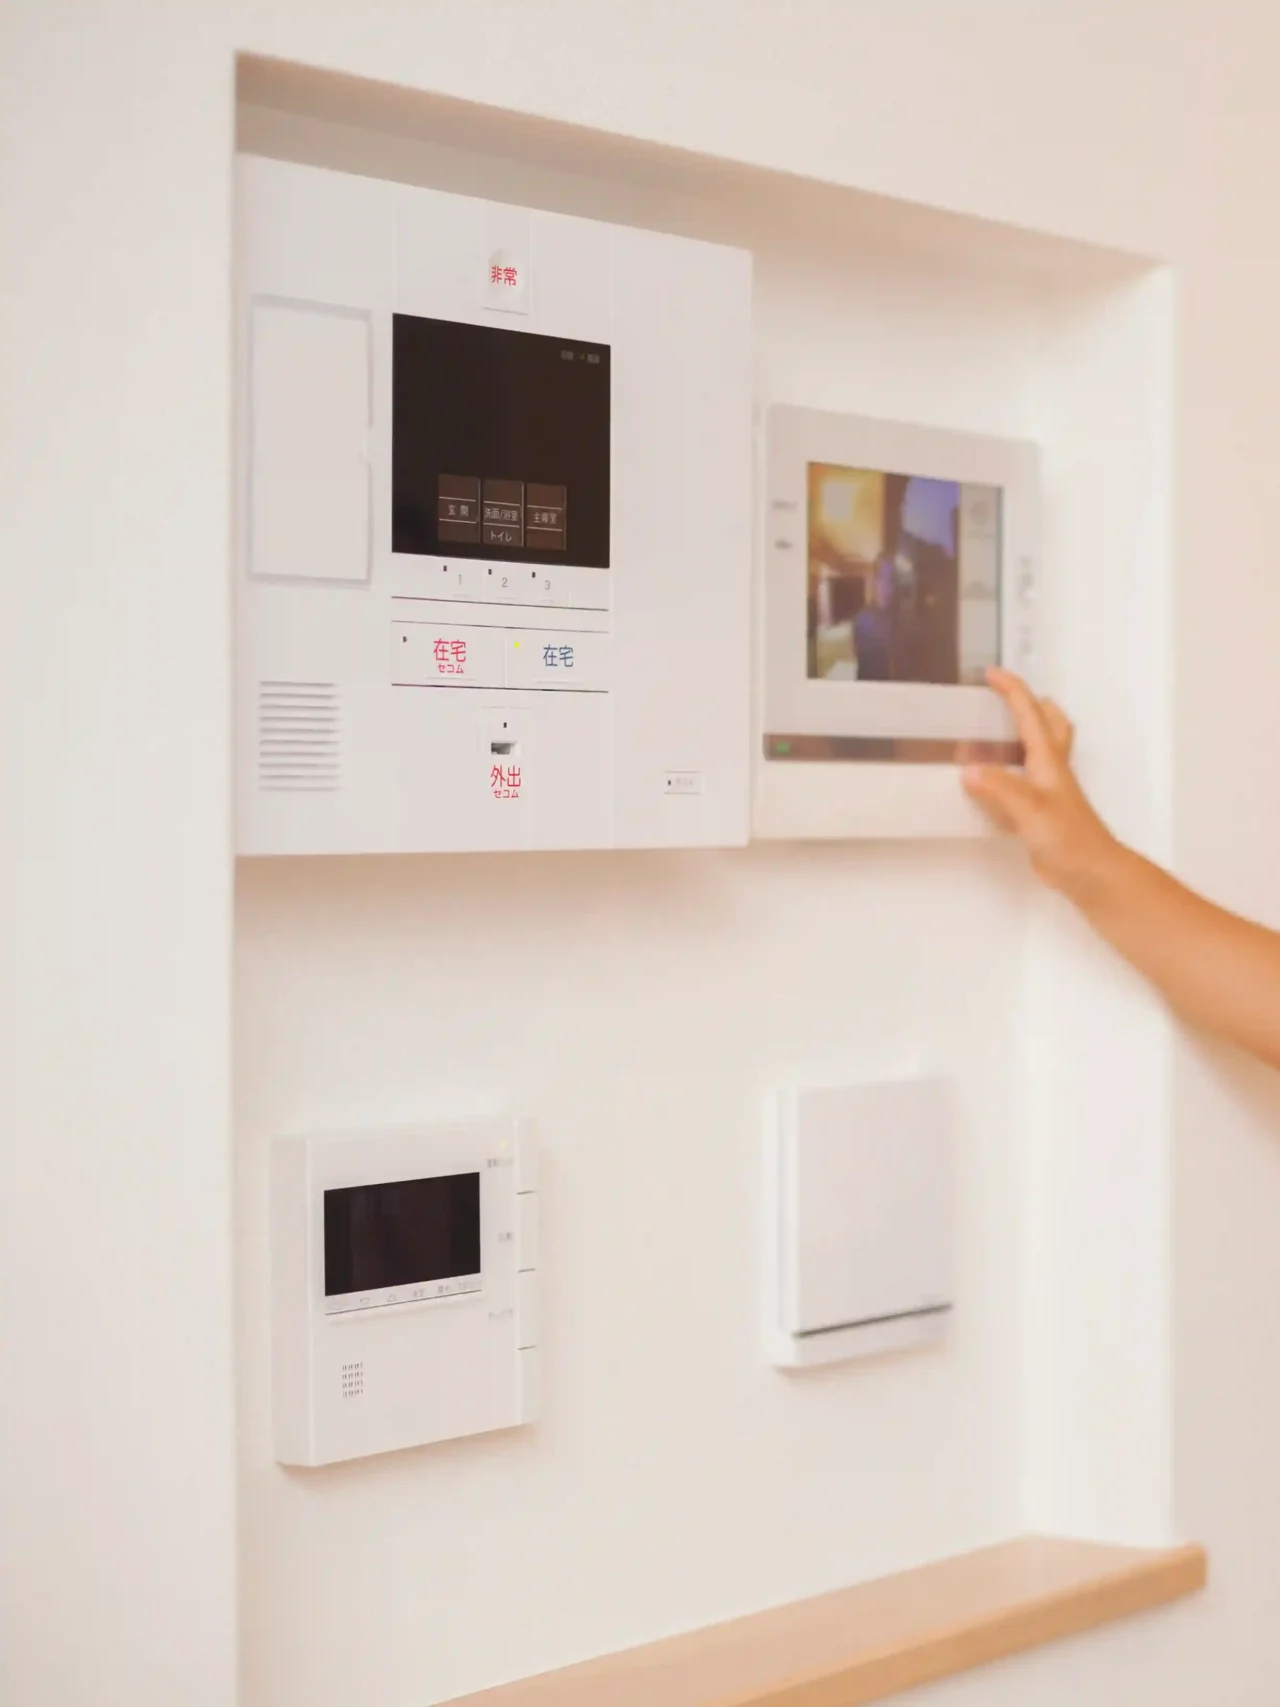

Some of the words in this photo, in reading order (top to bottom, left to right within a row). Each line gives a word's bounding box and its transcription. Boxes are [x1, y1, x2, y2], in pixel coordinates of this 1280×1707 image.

[491, 264, 517, 287] 非常
[448, 504, 469, 517] 玄関
[491, 530, 512, 542] トイレ
[501, 577, 508, 588] 2
[544, 580, 551, 590] 3
[433, 638, 467, 663] 在宅
[542, 644, 574, 668] 在宅
[437, 663, 464, 674] セコム
[490, 764, 522, 787] 外出
[493, 789, 519, 799] セコム
